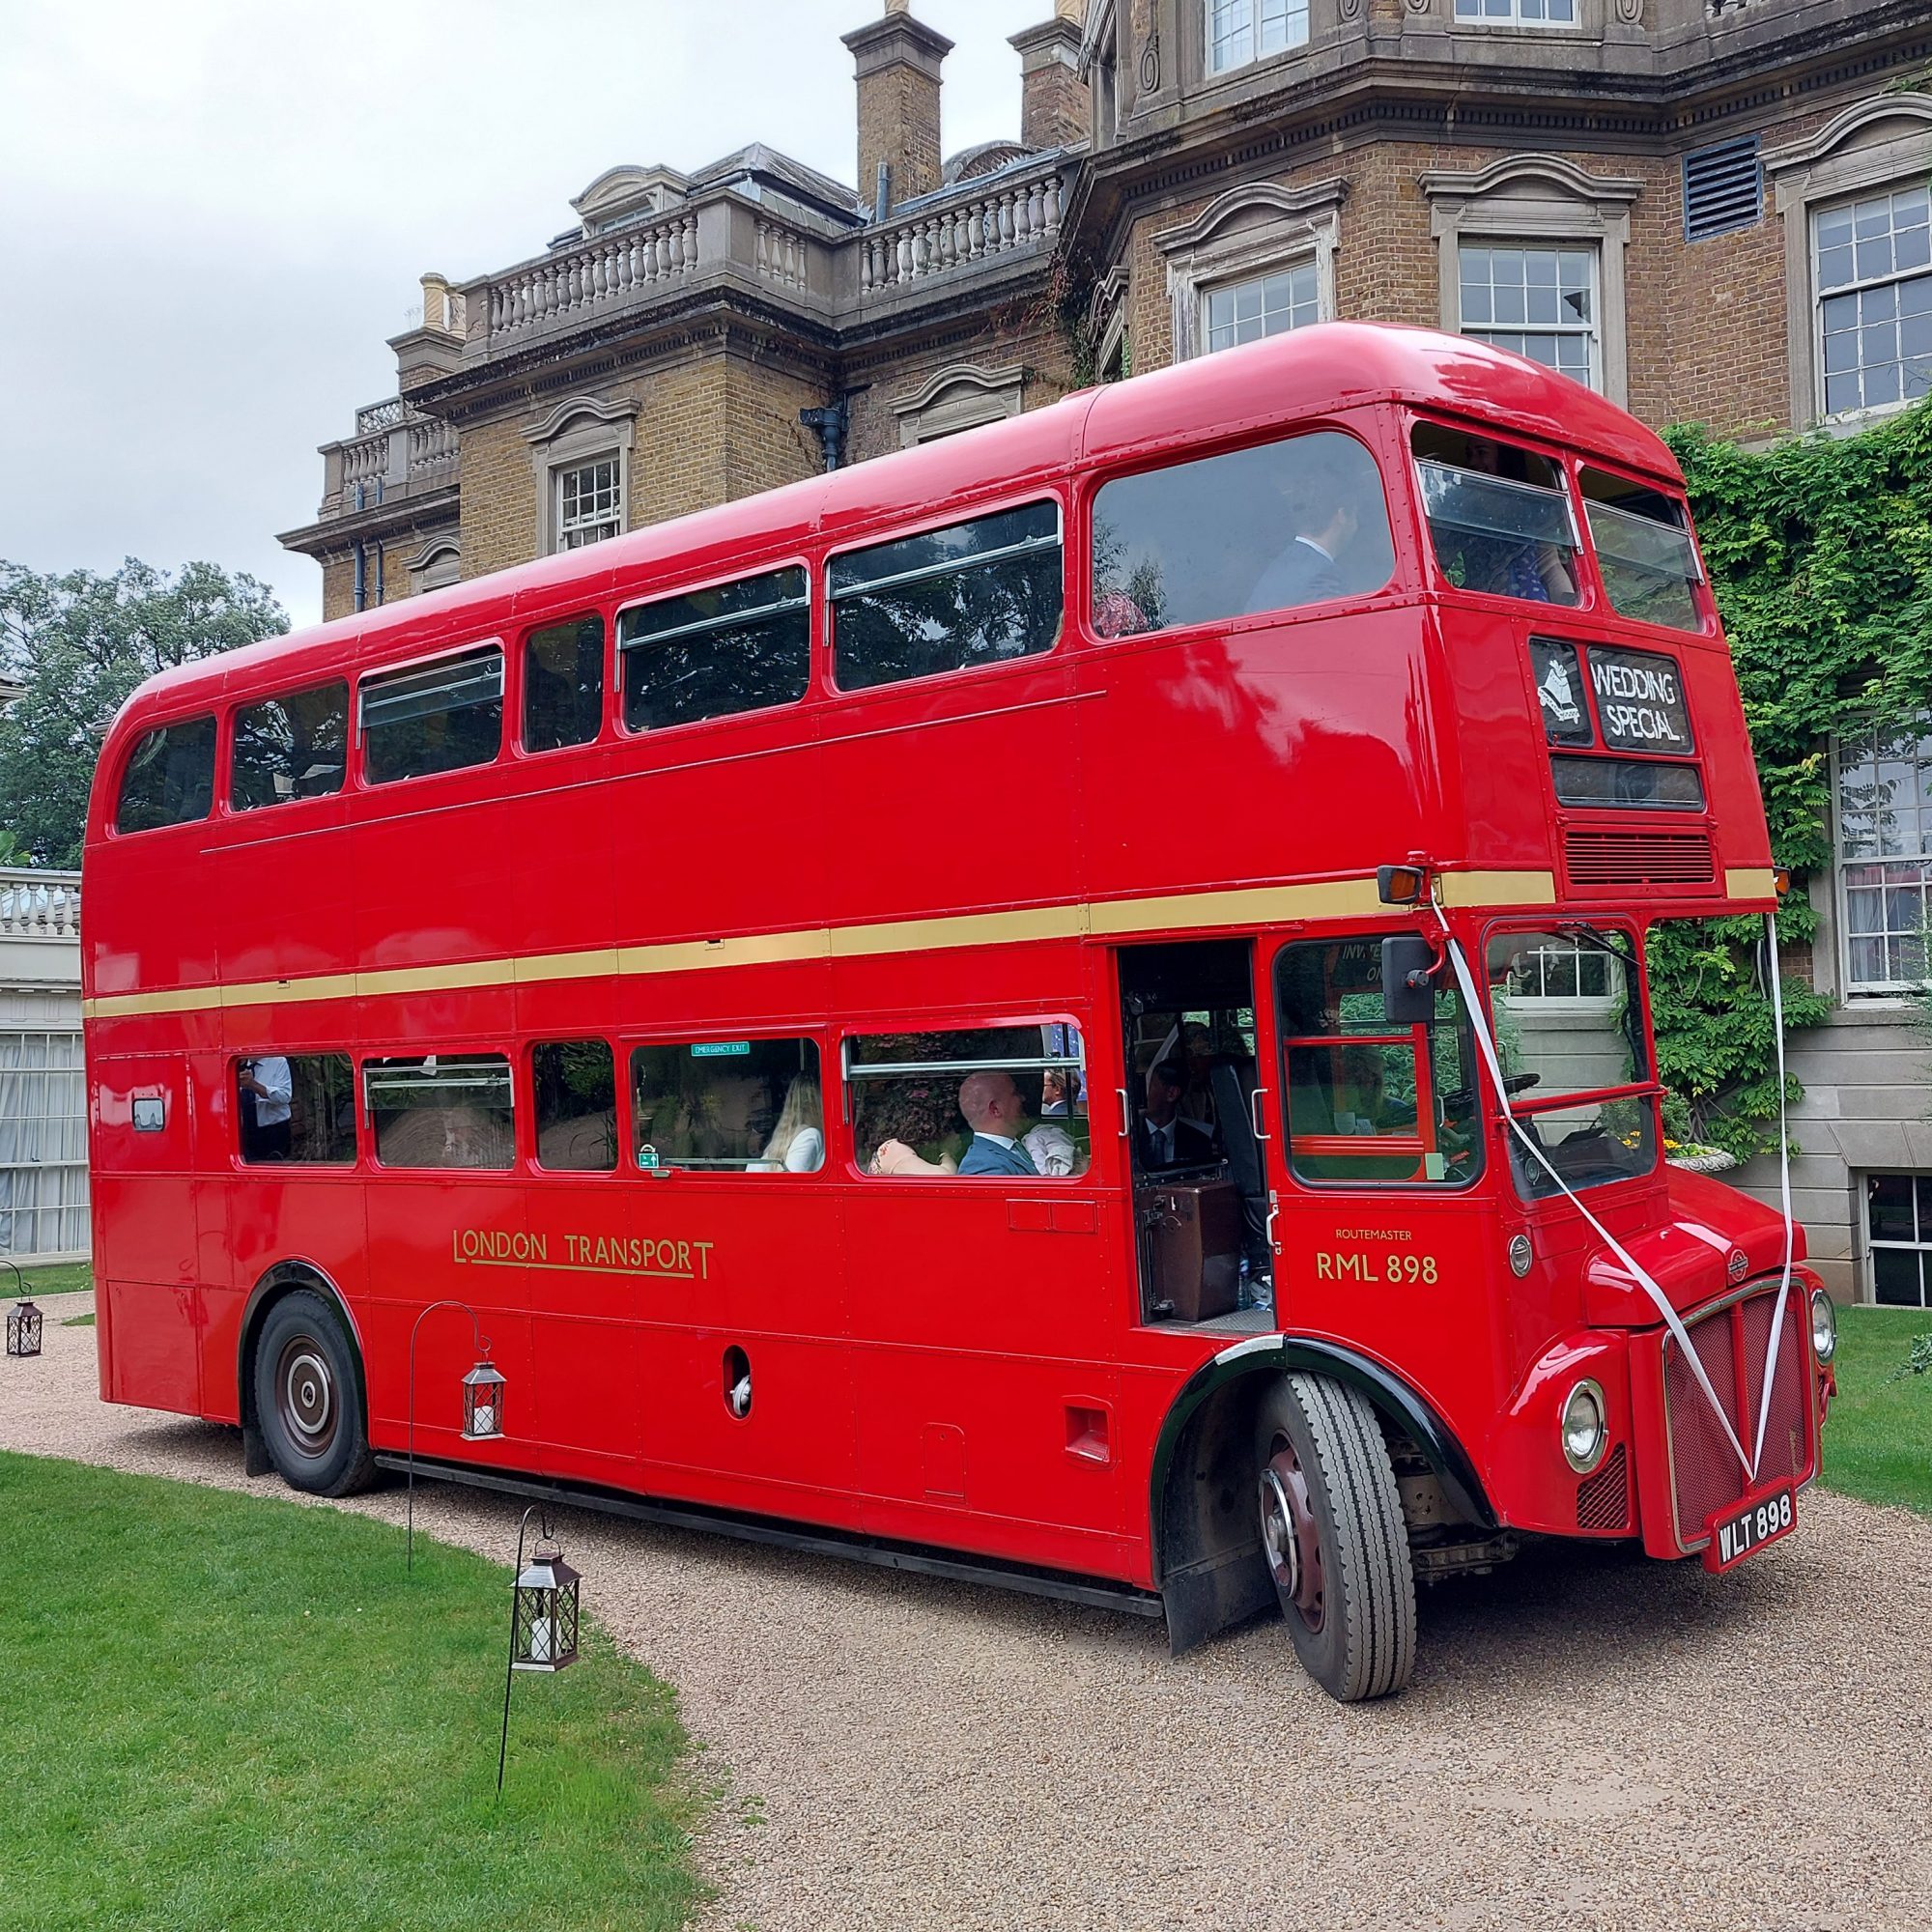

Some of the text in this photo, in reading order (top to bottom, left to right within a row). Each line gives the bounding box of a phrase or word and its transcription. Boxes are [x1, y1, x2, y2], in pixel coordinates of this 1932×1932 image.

[1590, 662, 1676, 705] WEDDING
[1606, 704, 1680, 741] SPECIAL
[695, 1043, 746, 1054] EMERGENCY EXIT
[1335, 1229, 1411, 1241] ROUTEMASTER
[453, 1230, 714, 1280] LONDON TRANSPORT
[1317, 1252, 1438, 1285] RML 898
[1719, 1494, 1791, 1563] WLT 898
